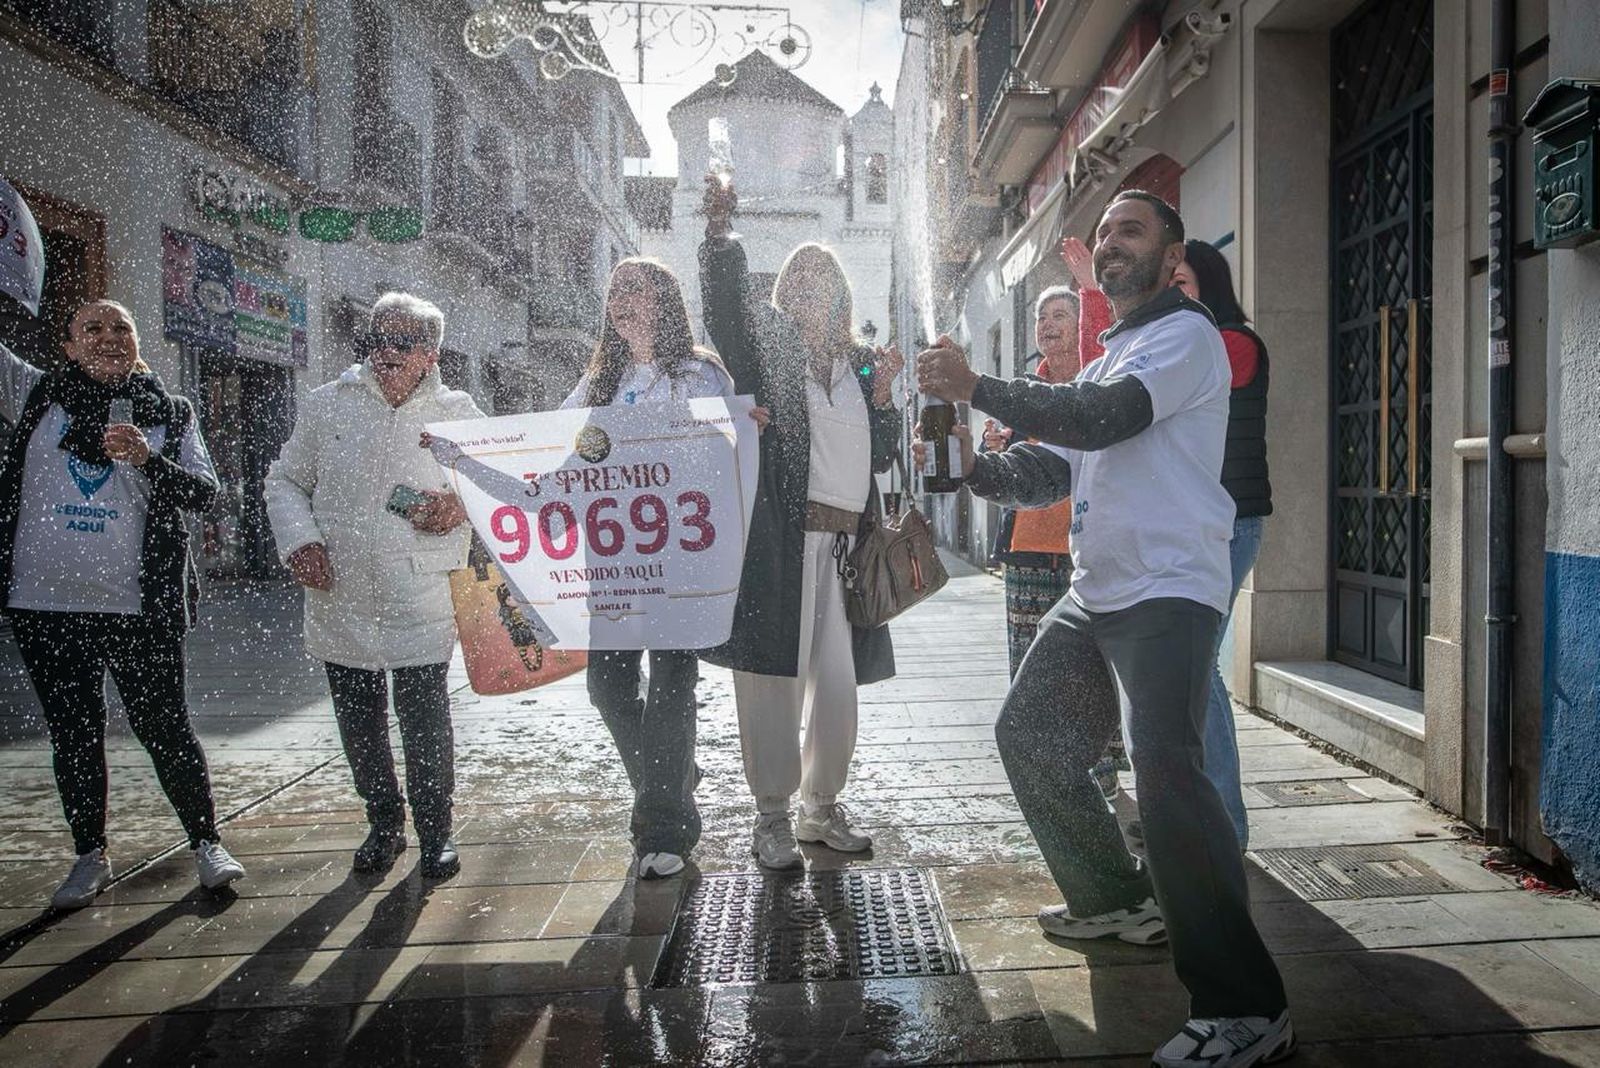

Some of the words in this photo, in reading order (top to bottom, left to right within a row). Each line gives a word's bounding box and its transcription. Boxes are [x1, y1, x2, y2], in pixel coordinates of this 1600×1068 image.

[555, 461, 671, 494] PREMIO
[490, 490, 716, 564] 90693
[549, 566, 620, 583] VENDIDO
[624, 560, 664, 581] AQUÍ
